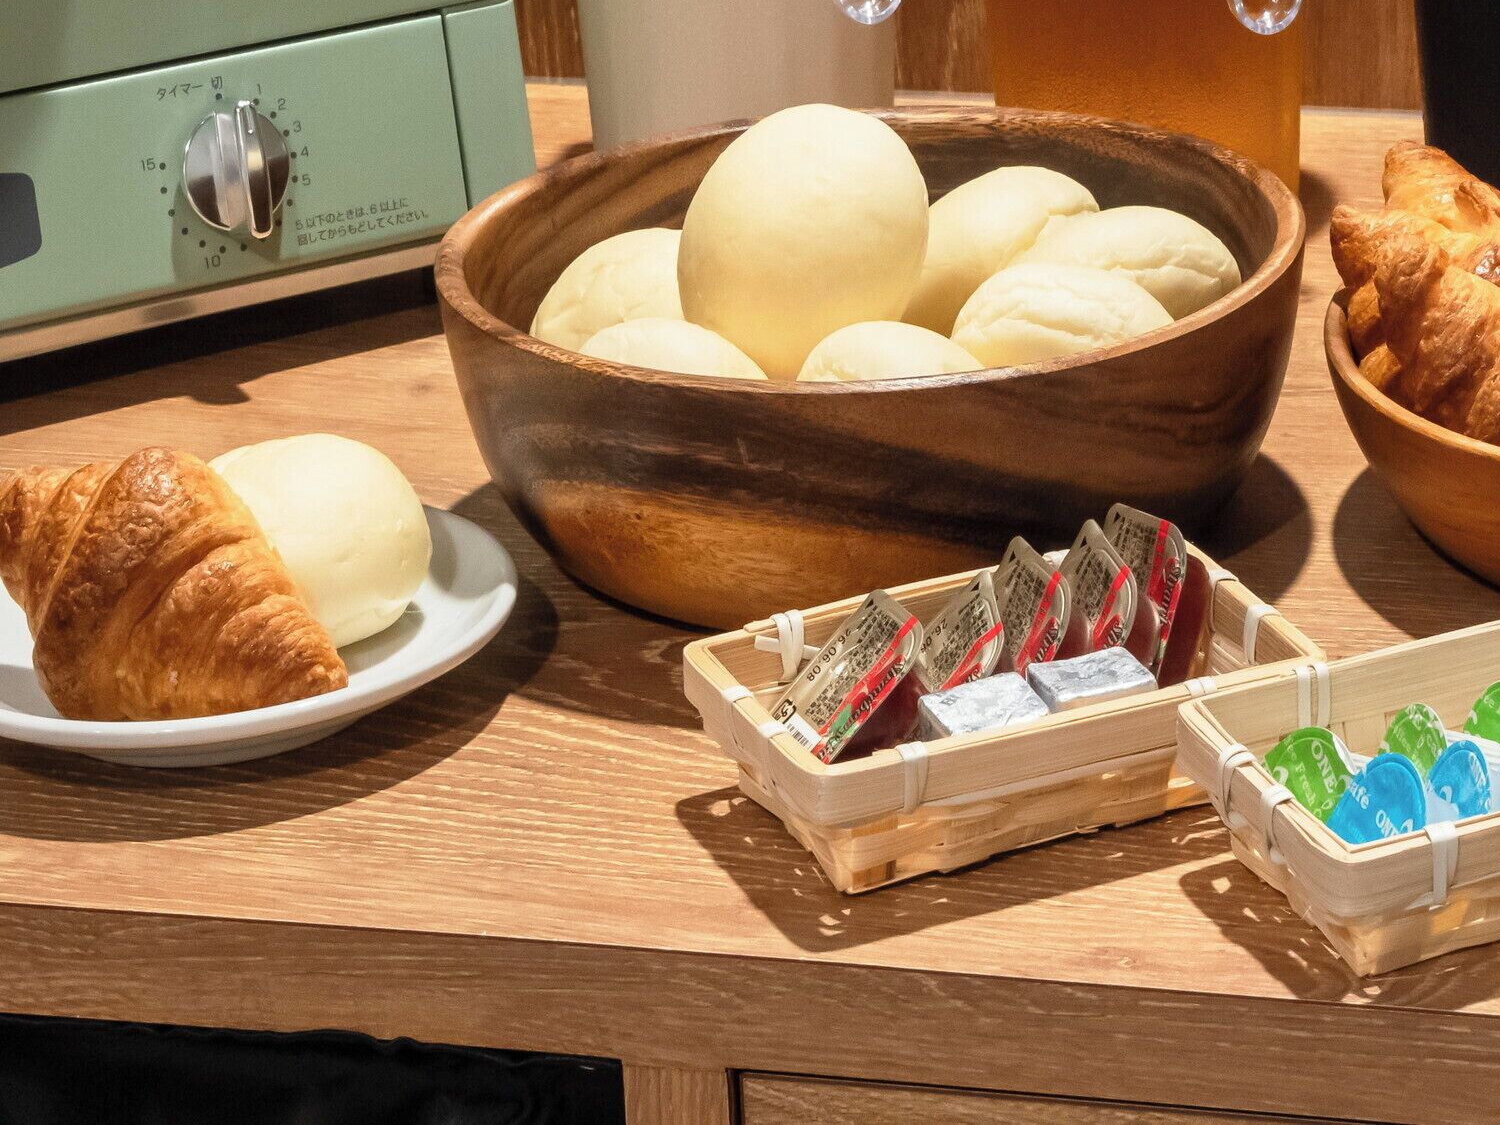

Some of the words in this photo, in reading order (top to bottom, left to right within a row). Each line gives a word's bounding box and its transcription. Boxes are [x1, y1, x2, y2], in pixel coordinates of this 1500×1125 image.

[157, 84, 203, 101] タイマー
[211, 76, 222, 90] 切
[277, 98, 286, 111] 2
[293, 121, 302, 133] 3
[300, 146, 309, 157] 4
[141, 159, 156, 171] 15
[302, 175, 311, 186] 5
[204, 255, 221, 270] 10
[1311, 740, 1339, 794] ONE
